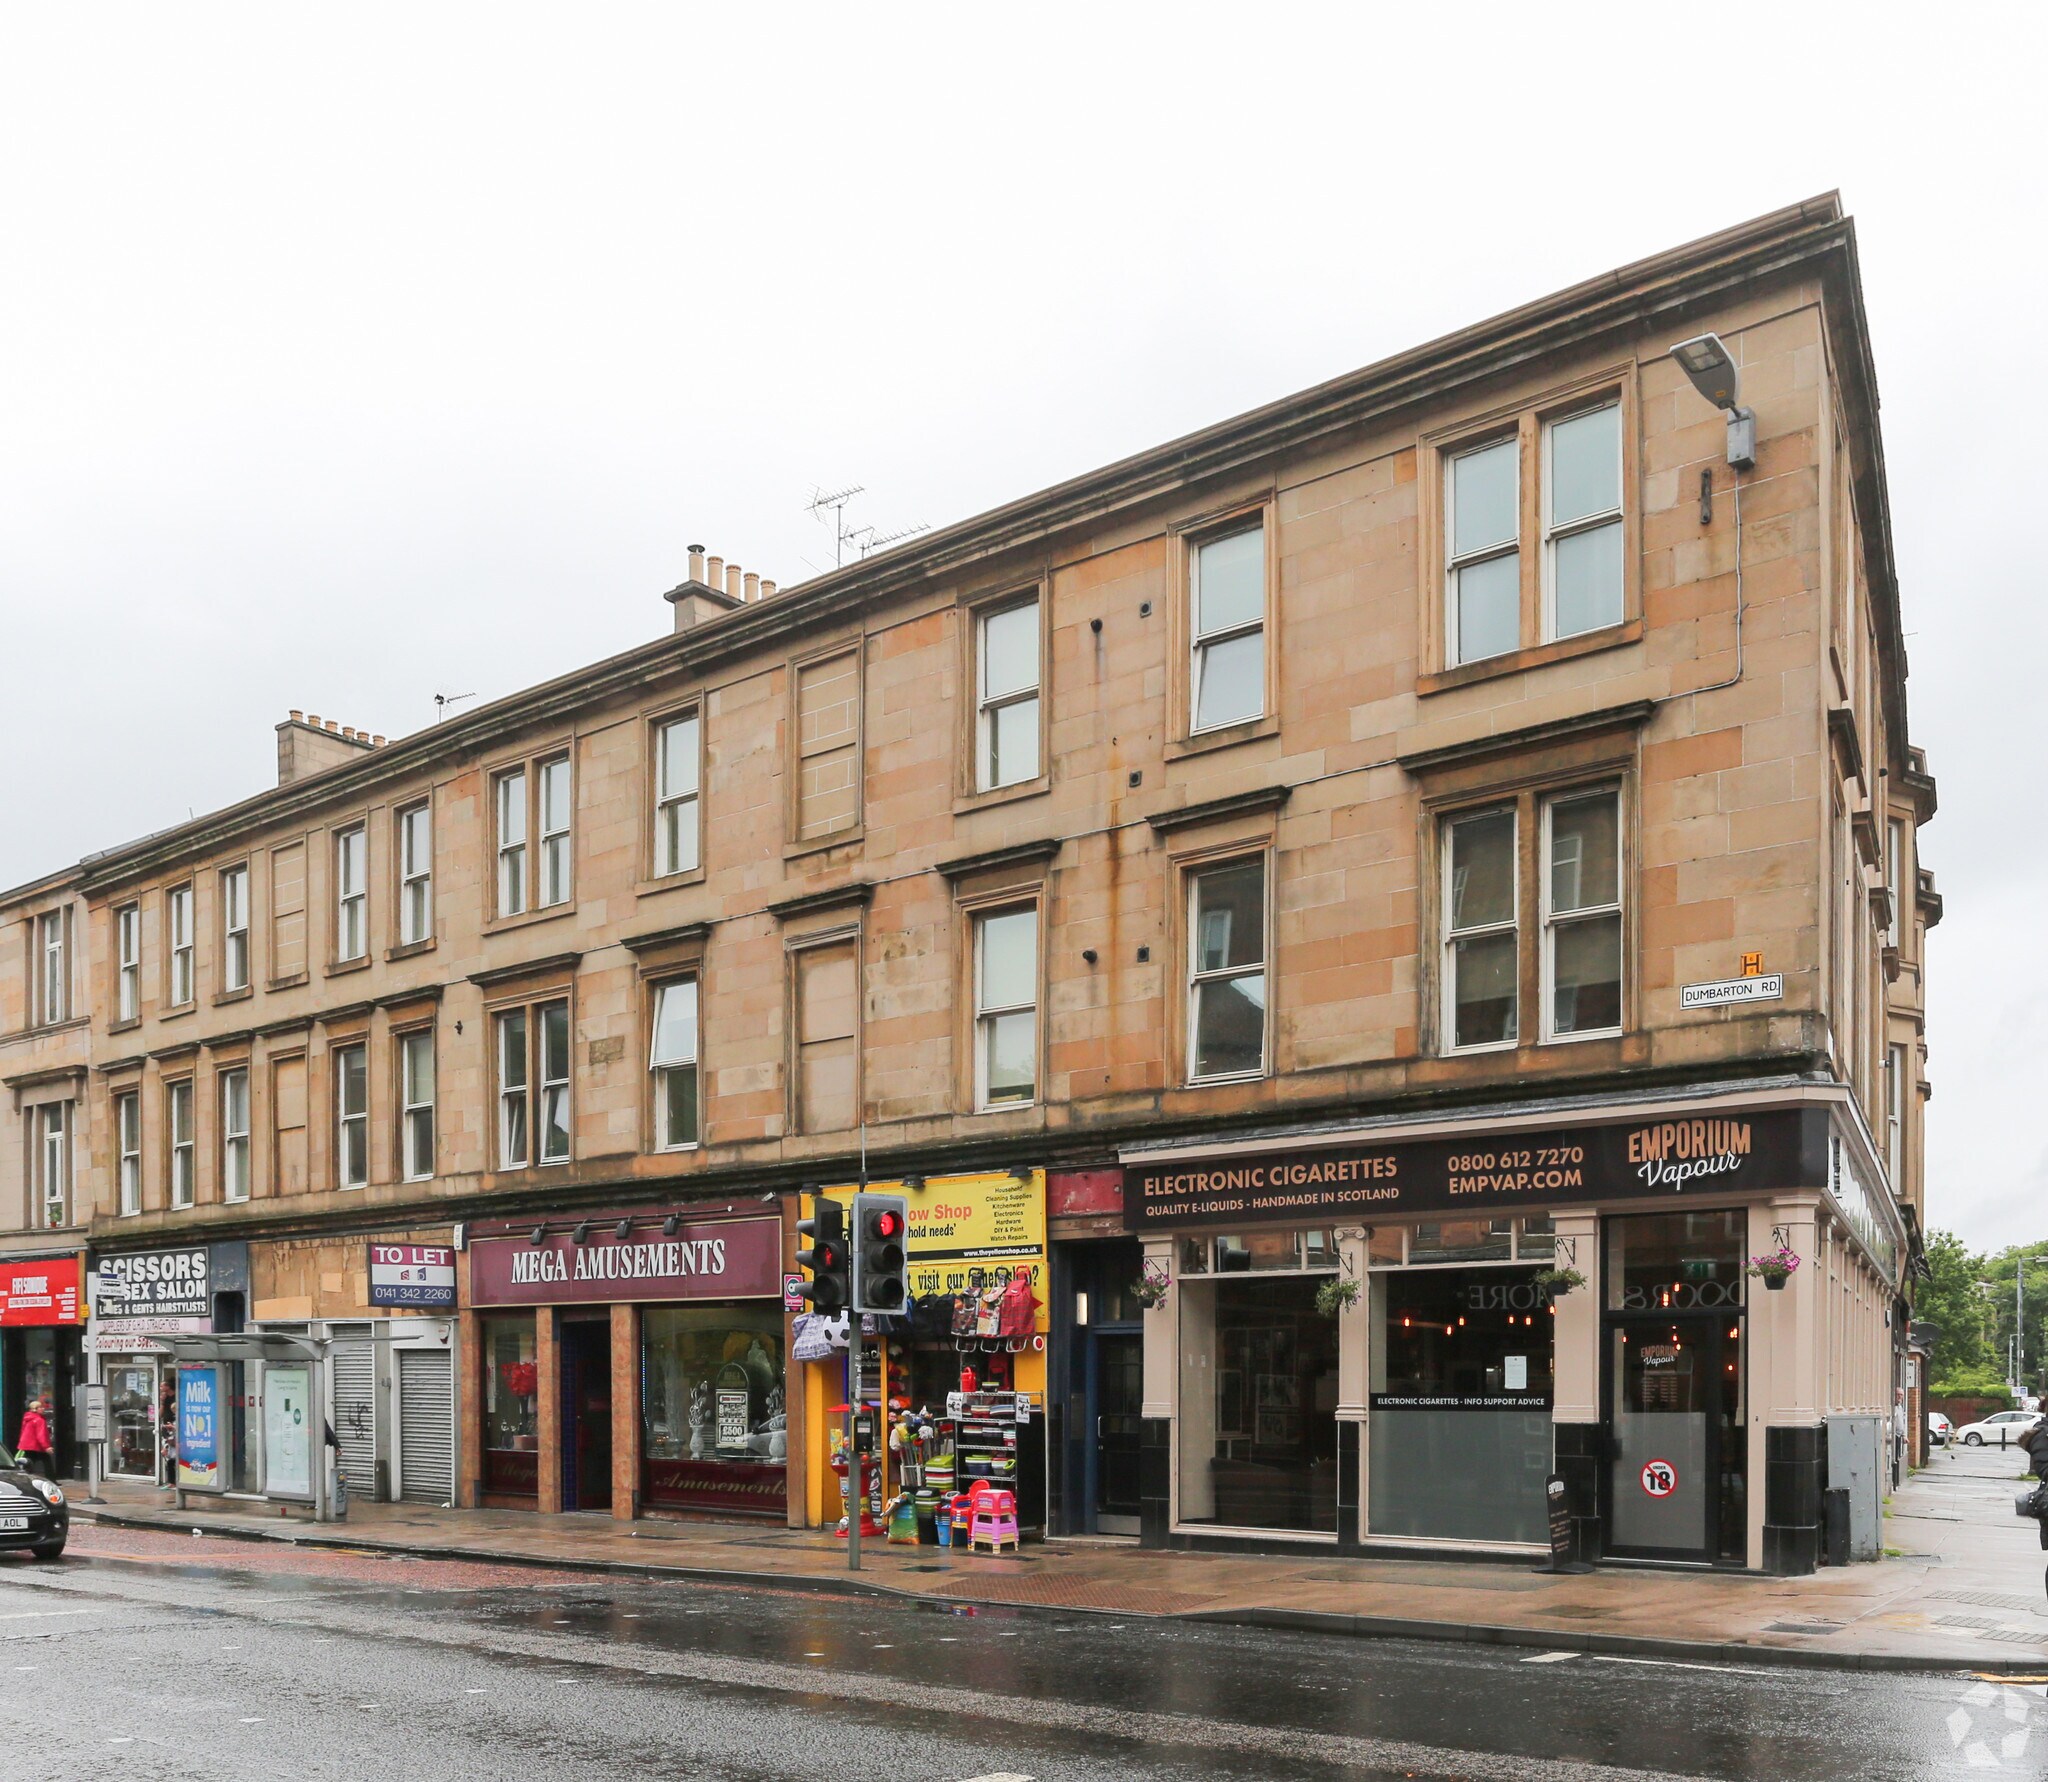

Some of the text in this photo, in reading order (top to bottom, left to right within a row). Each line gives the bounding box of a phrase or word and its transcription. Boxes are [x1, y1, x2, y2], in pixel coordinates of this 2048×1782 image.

[1743, 953, 1760, 975] H
[1685, 984, 1753, 1002] DUMBARTON
[1628, 1119, 1751, 1164] EMPORIUM
[1447, 1146, 1584, 1173] 0800 612 7270
[1637, 1149, 1741, 1191] Vapour
[1144, 1156, 1398, 1197] ELECTRONIC CIGARETTES
[1449, 1169, 1583, 1195] EMPVAP.COM
[1009, 1193, 1032, 1201] Supplies
[1146, 1203, 1189, 1217] QUALITY
[1192, 1200, 1244, 1214] E-LIQUIDS
[1252, 1194, 1318, 1209] HANDMADE
[1321, 1193, 1335, 1203] IN
[1337, 1188, 1399, 1203] SCOTLAND
[934, 1204, 972, 1221] Shop
[994, 1210, 1024, 1218] Electronics
[375, 1246, 449, 1265] TO LET
[511, 1239, 726, 1284] MEGA AMUSEMENTS
[156, 1280, 206, 1300] SALON
[918, 1269, 940, 1290] visit
[946, 1273, 965, 1289] our
[375, 1287, 452, 1299] 0141 342 2260
[125, 1304, 130, 1314] &
[132, 1302, 155, 1314] GENTS
[155, 1301, 206, 1314] HAIRSTYLISTS
[1640, 1344, 1679, 1358] EMPORIUM
[1643, 1355, 1675, 1367] Vapour
[186, 1381, 211, 1403] Milk
[1377, 1397, 1418, 1406] ELECTRONIC
[1418, 1397, 1459, 1406] CIGARETTES
[1464, 1397, 1482, 1405] INFO
[1483, 1397, 1516, 1406] SUPPORT
[1517, 1397, 1545, 1406] ADVICE
[655, 1472, 787, 1497] Amusements
[1646, 1470, 1671, 1491] 18
